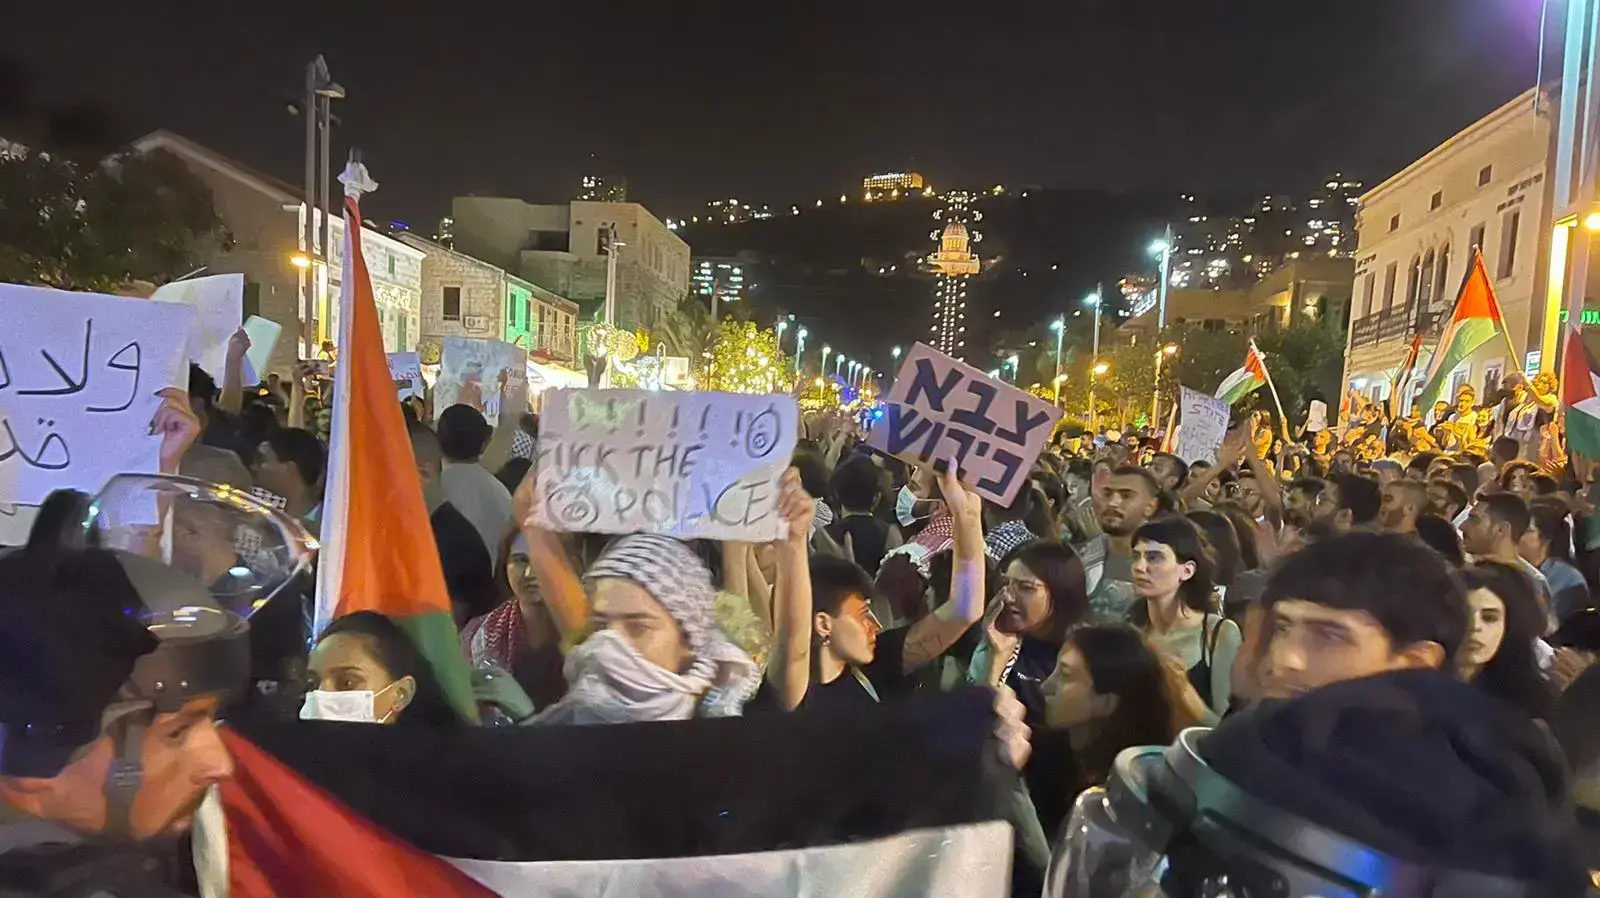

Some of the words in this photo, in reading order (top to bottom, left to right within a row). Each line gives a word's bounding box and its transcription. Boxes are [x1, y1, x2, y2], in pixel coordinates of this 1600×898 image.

[904, 358, 1050, 447] צבא
[627, 441, 704, 480] THE
[886, 402, 1024, 497] כיבוש
[612, 479, 773, 527] POLICE
